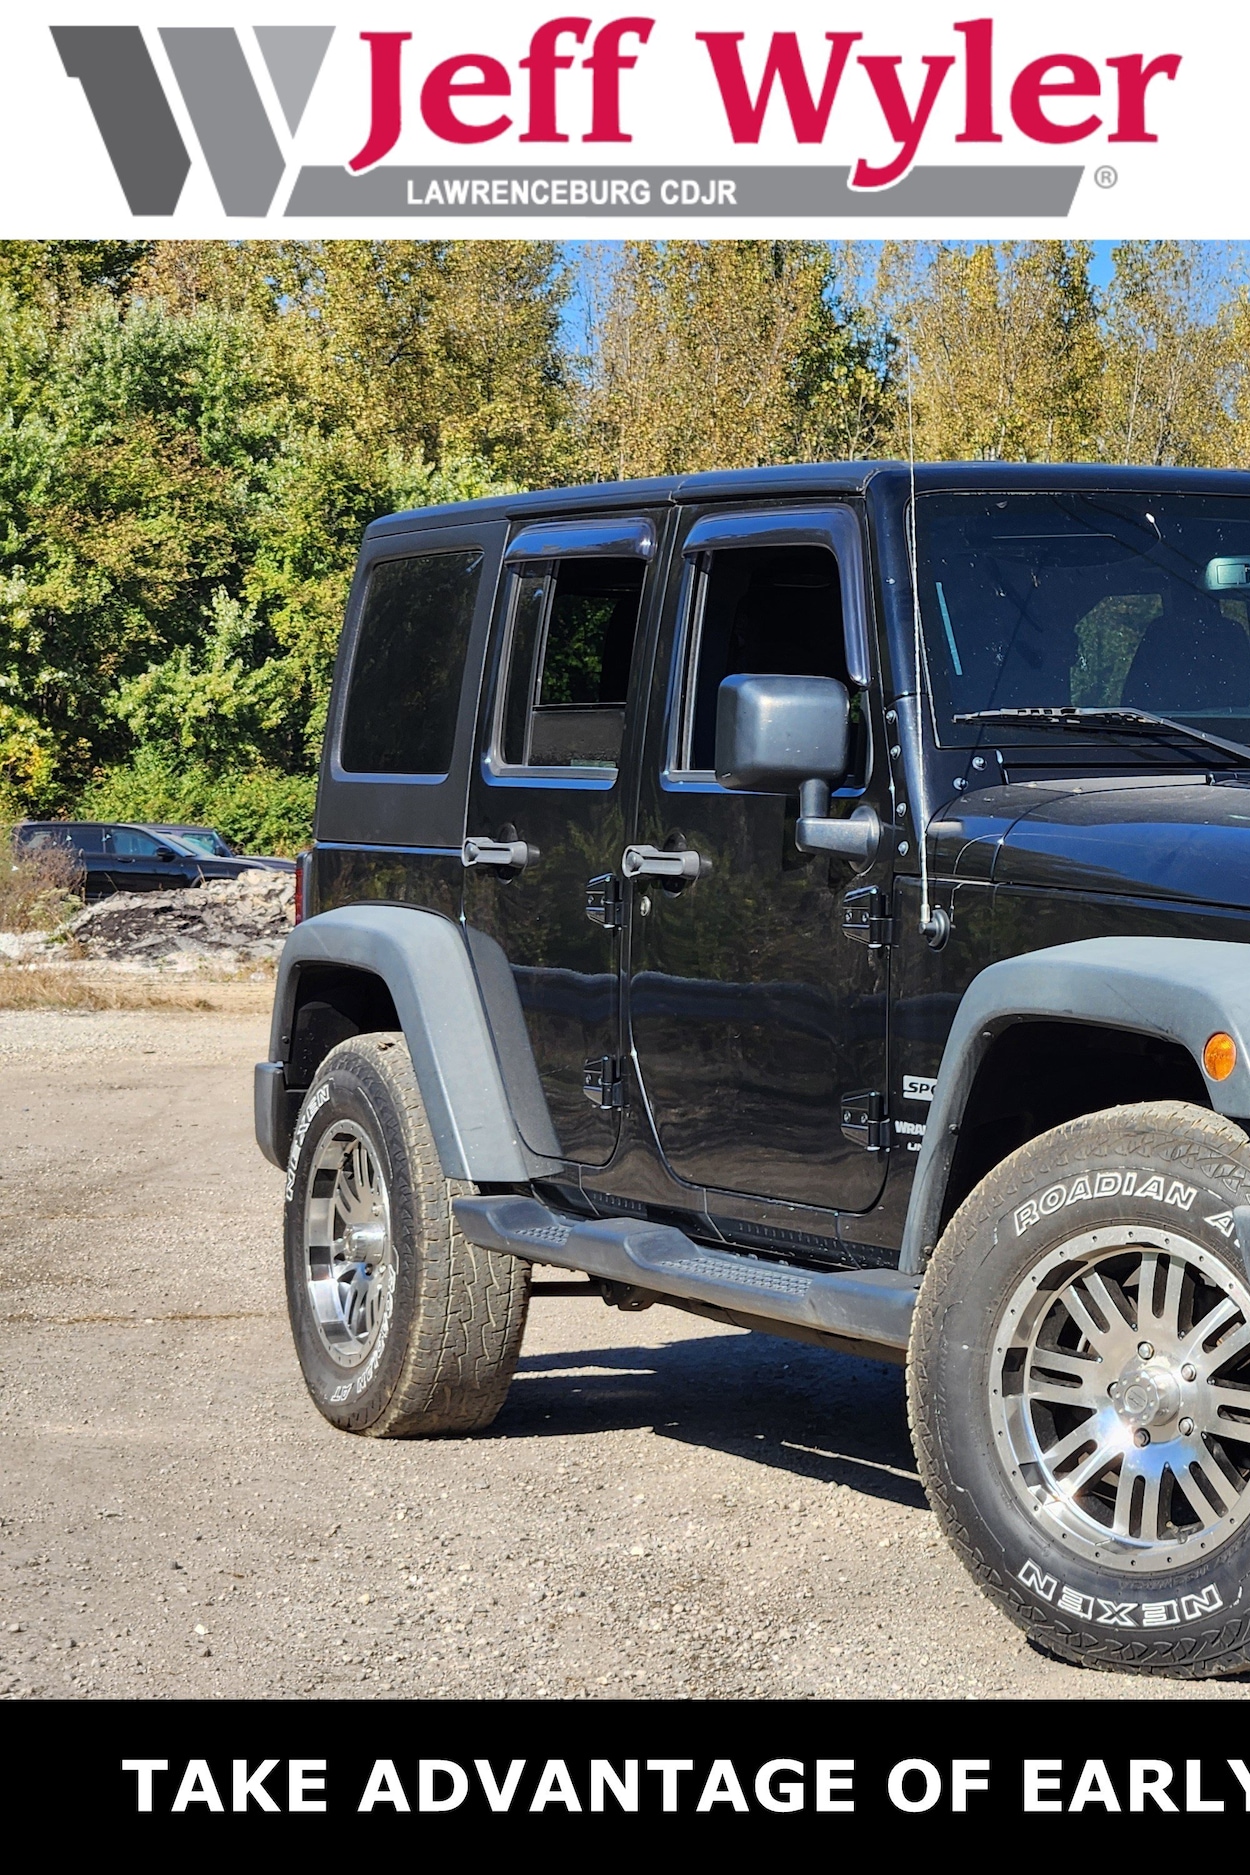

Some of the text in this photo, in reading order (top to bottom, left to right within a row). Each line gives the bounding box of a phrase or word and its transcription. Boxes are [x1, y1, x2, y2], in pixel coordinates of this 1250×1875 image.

[908, 1082, 936, 1095] SP
[286, 1083, 331, 1202] NEXEN
[1013, 1171, 1198, 1237] ROADIAN
[1018, 1557, 1224, 1627] NEXEN
